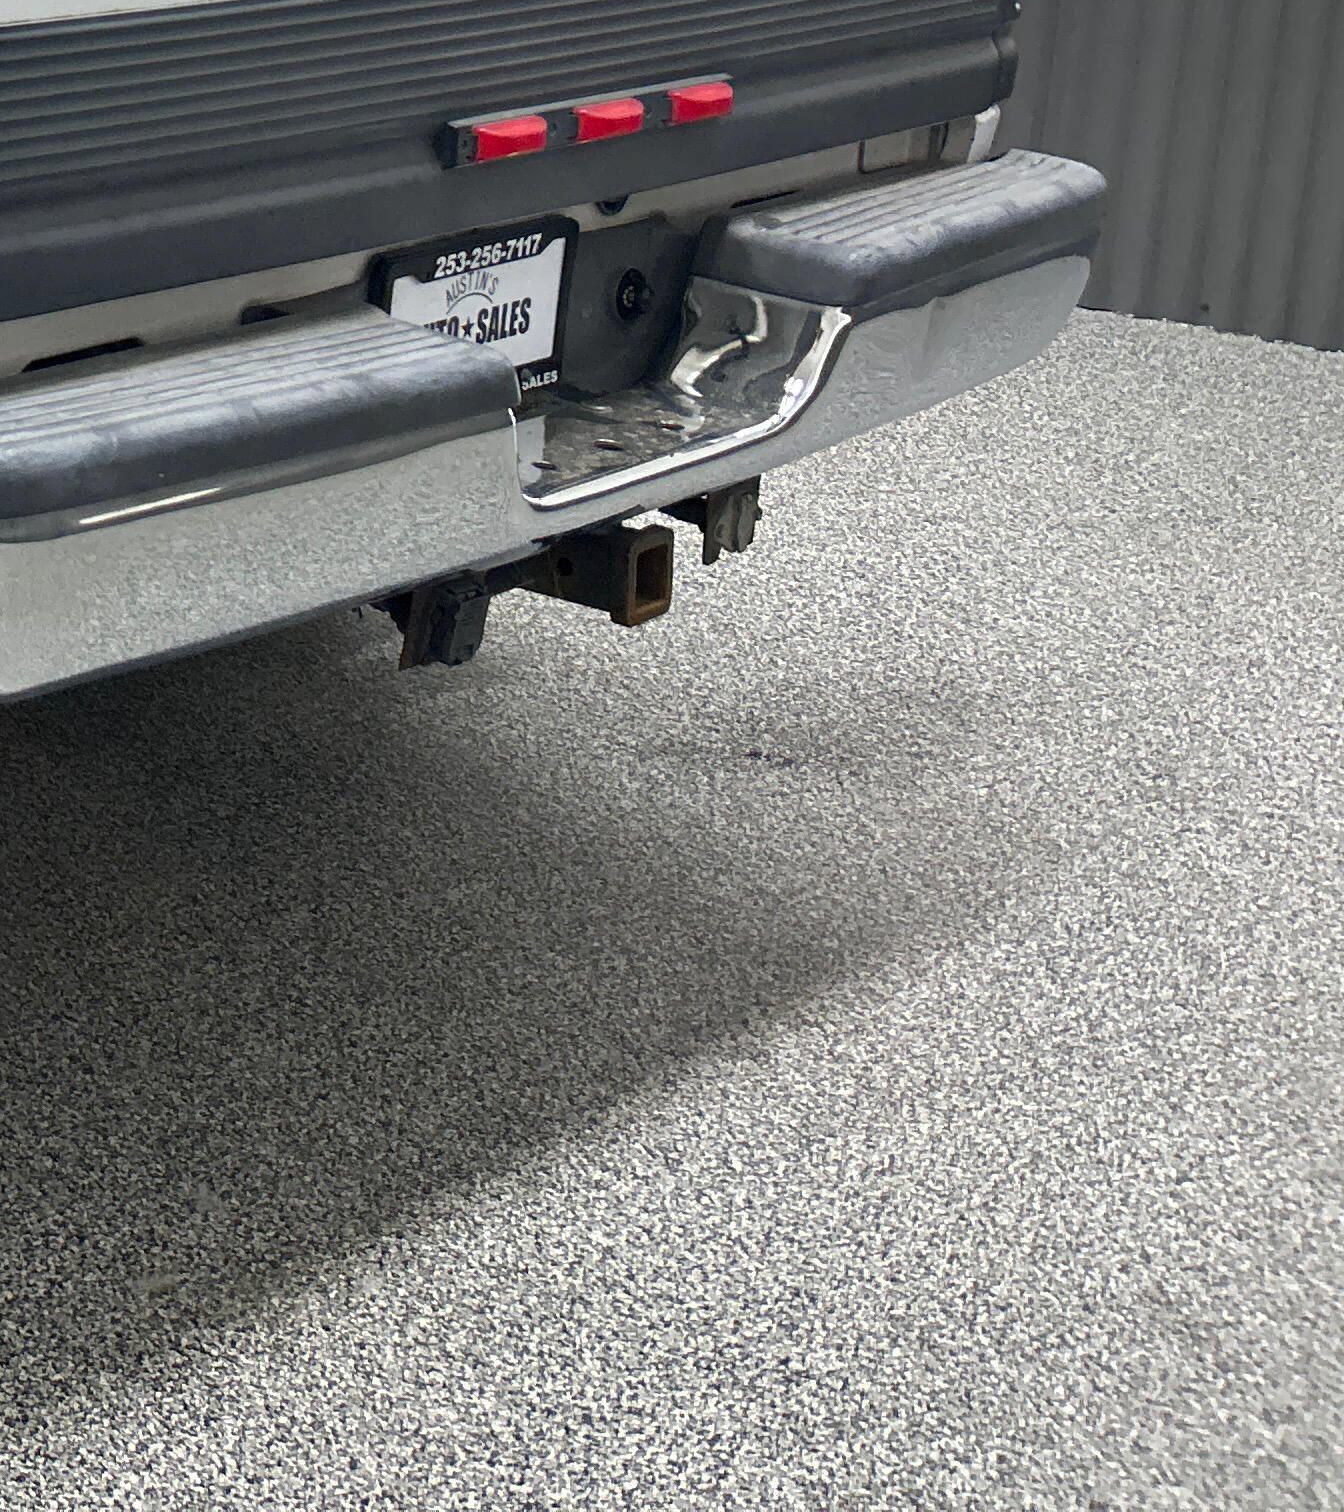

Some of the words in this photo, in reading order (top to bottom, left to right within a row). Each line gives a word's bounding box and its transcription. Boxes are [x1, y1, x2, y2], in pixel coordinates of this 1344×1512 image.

[433, 232, 543, 279] 253-256-7117
[445, 270, 499, 307] AUSTIN'S
[475, 297, 532, 345] SALES
